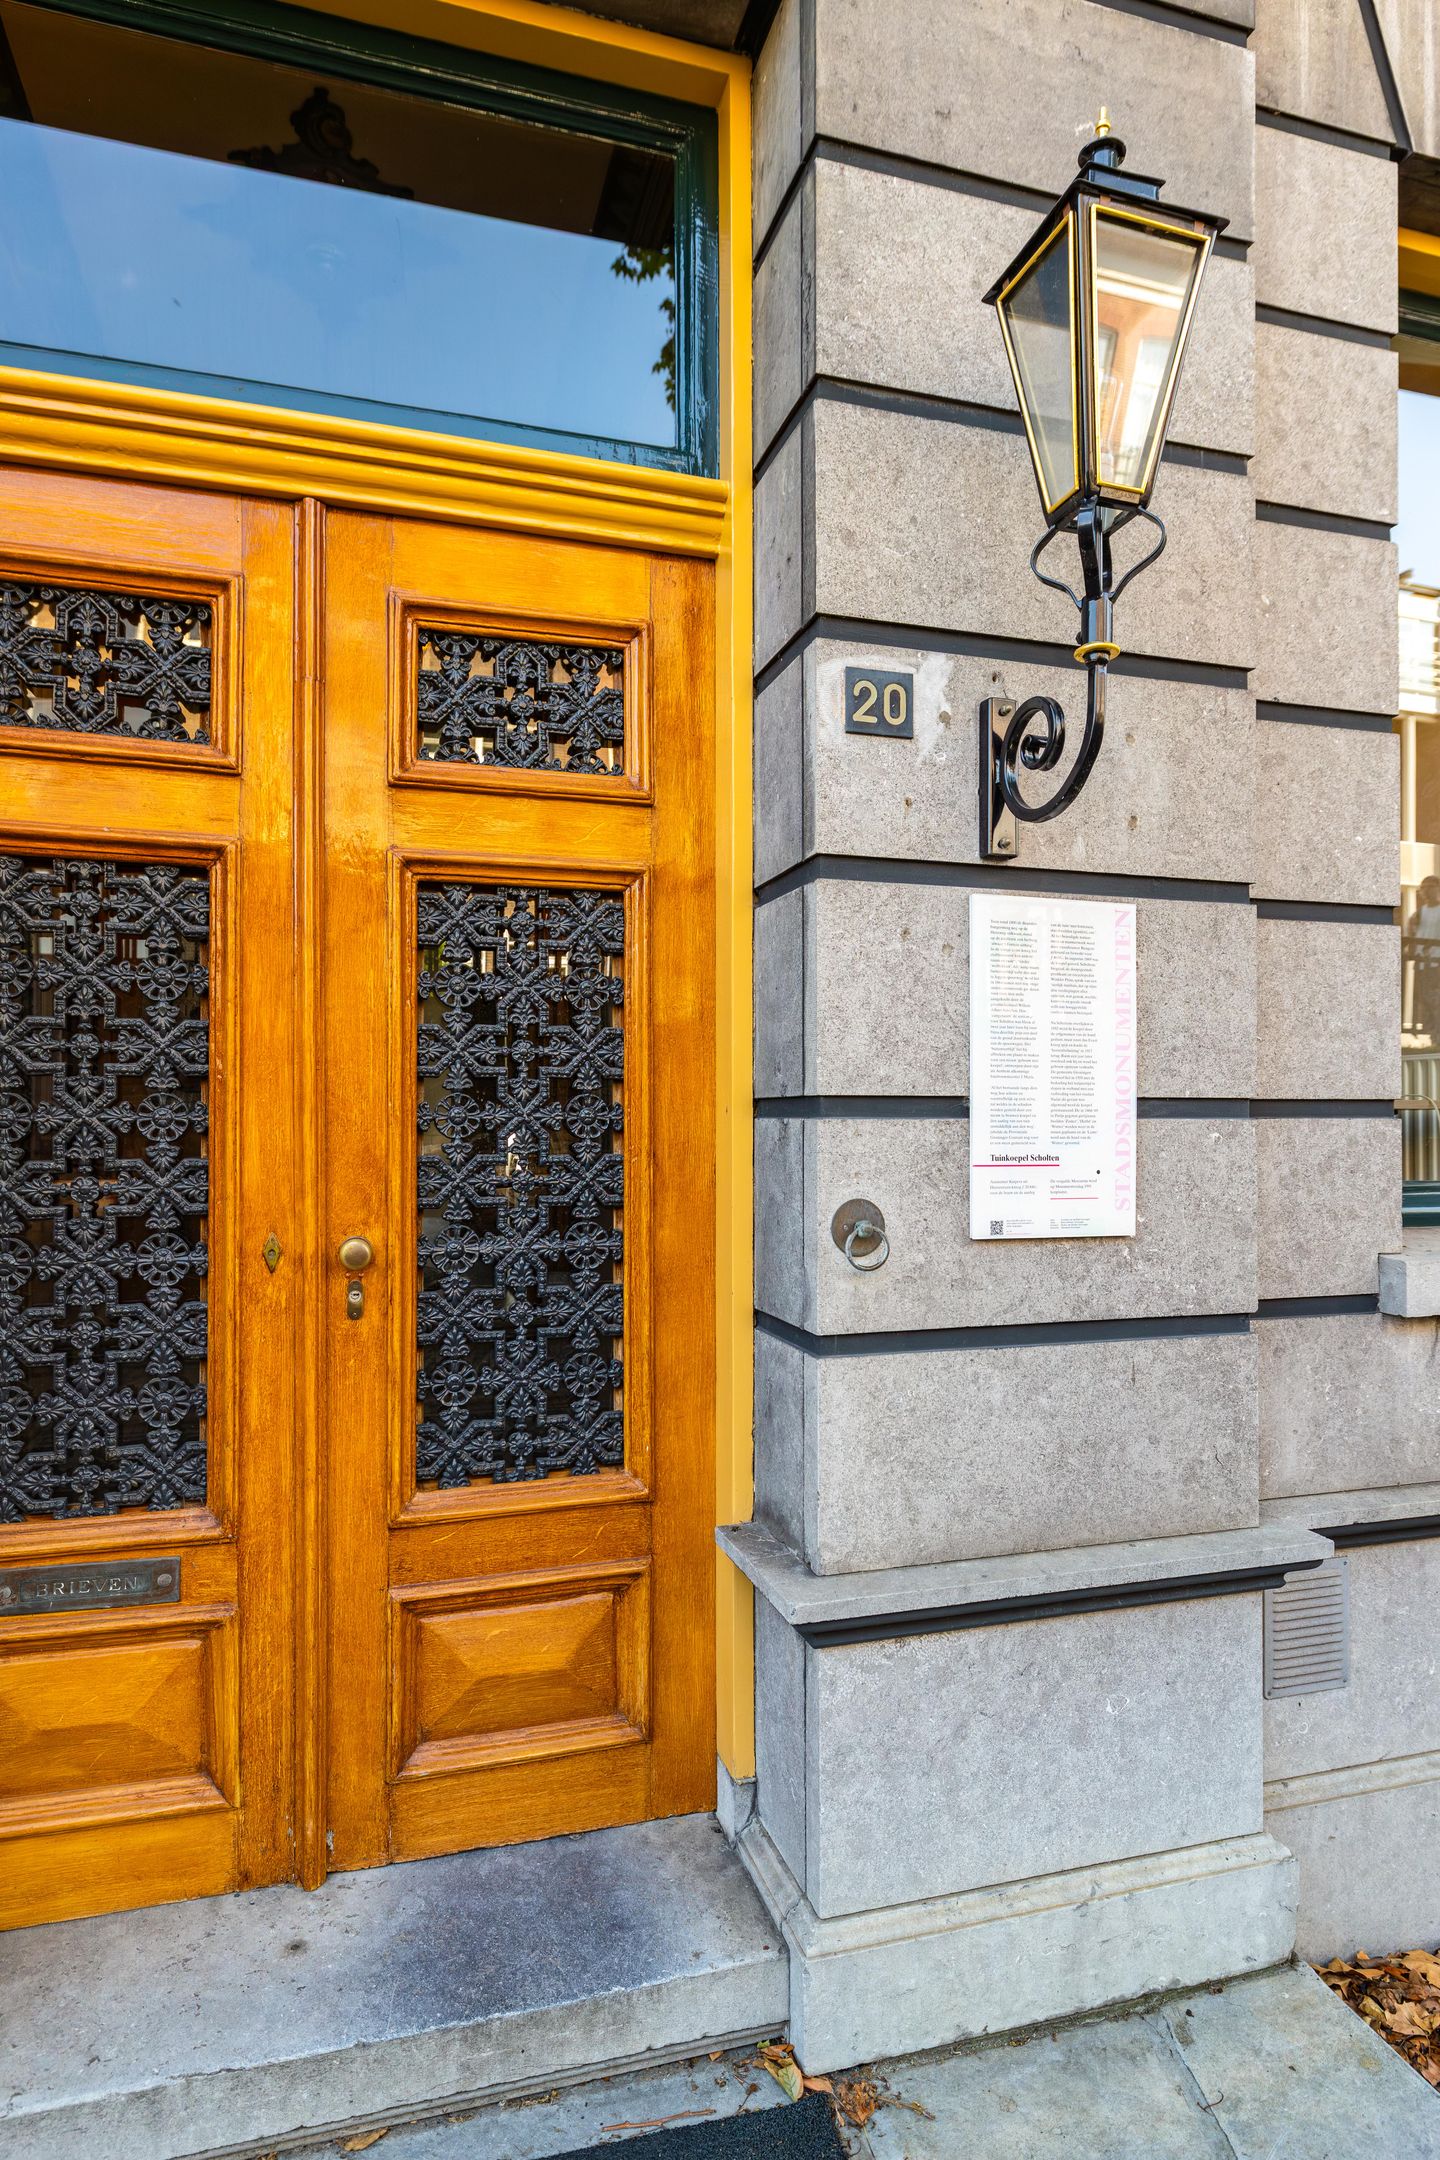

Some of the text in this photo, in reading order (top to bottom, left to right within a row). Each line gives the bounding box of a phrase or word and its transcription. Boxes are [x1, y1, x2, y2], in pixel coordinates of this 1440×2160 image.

[852, 680, 907, 726] 20
[1114, 909, 1132, 1211] STADSMONUMENTEN
[990, 1154, 1060, 1163] Tuinkoepel Scholten
[36, 1576, 138, 1598] BRIEVEN
